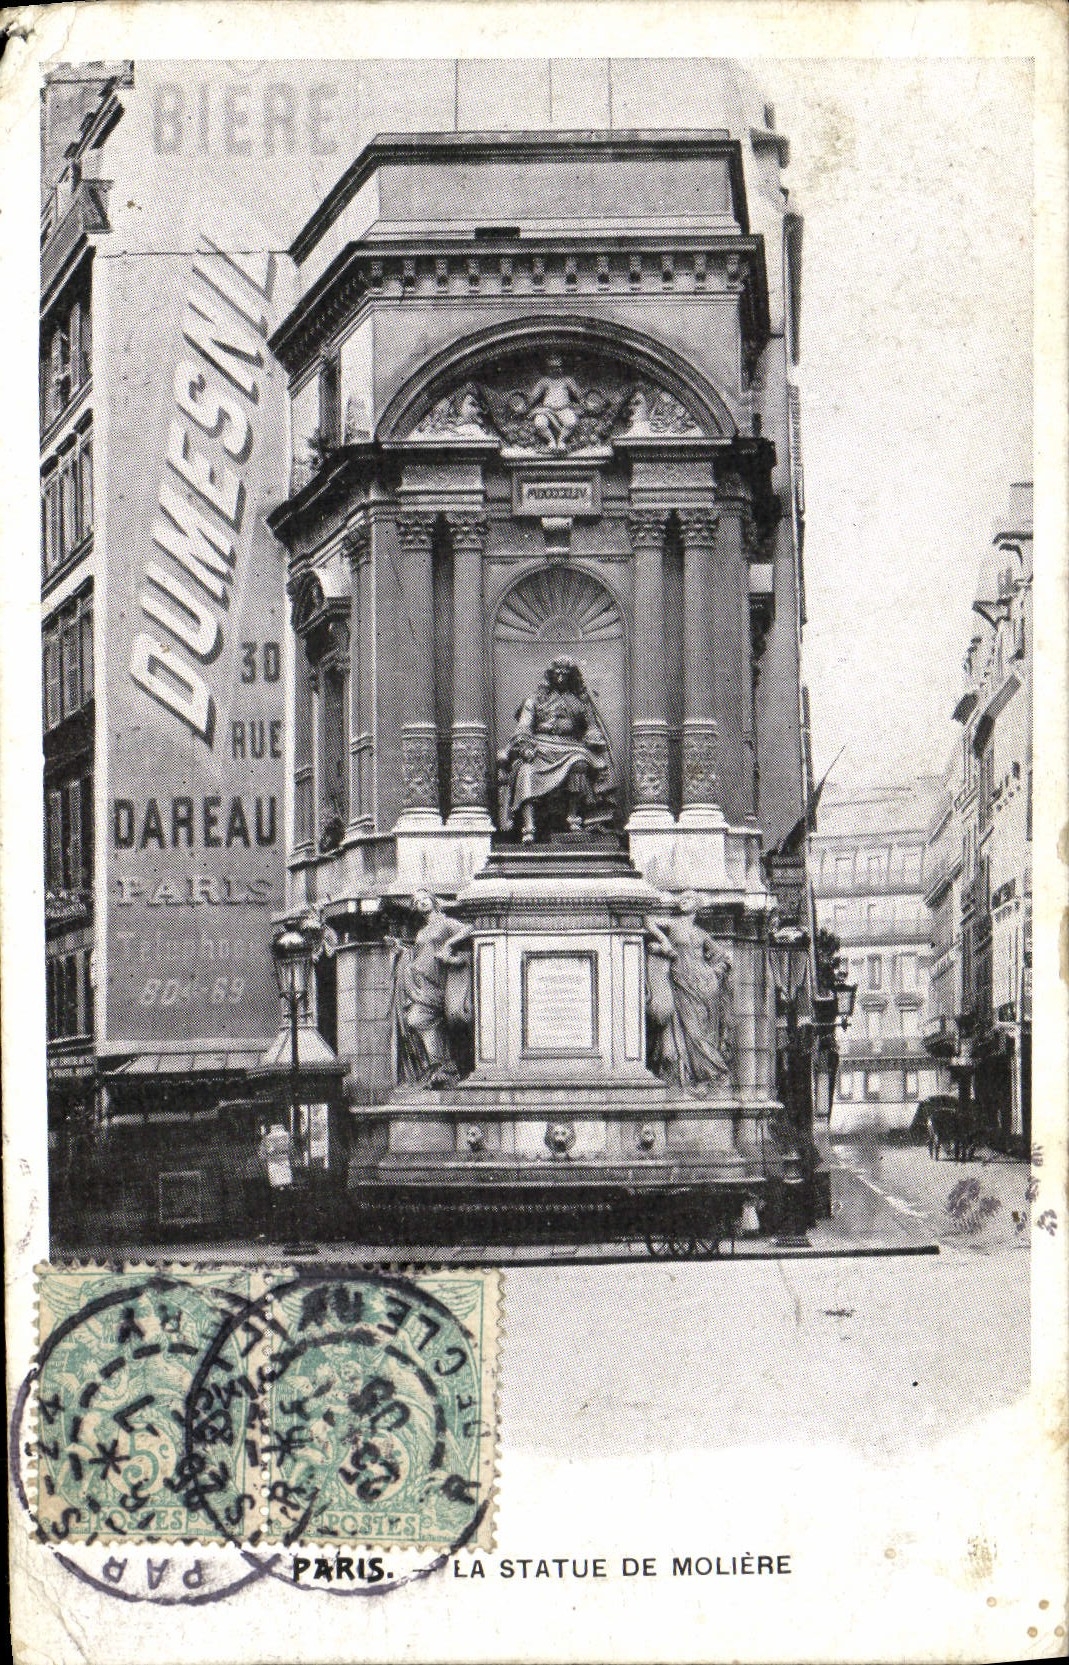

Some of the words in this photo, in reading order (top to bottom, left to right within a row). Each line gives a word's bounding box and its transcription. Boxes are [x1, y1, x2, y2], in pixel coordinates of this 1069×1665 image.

[153, 82, 338, 158] BIERE
[129, 225, 278, 750] DUMESNIL
[241, 641, 280, 684] 30
[230, 720, 282, 760] RUE
[113, 797, 277, 850] DAREAU
[116, 874, 273, 907] PARIS
